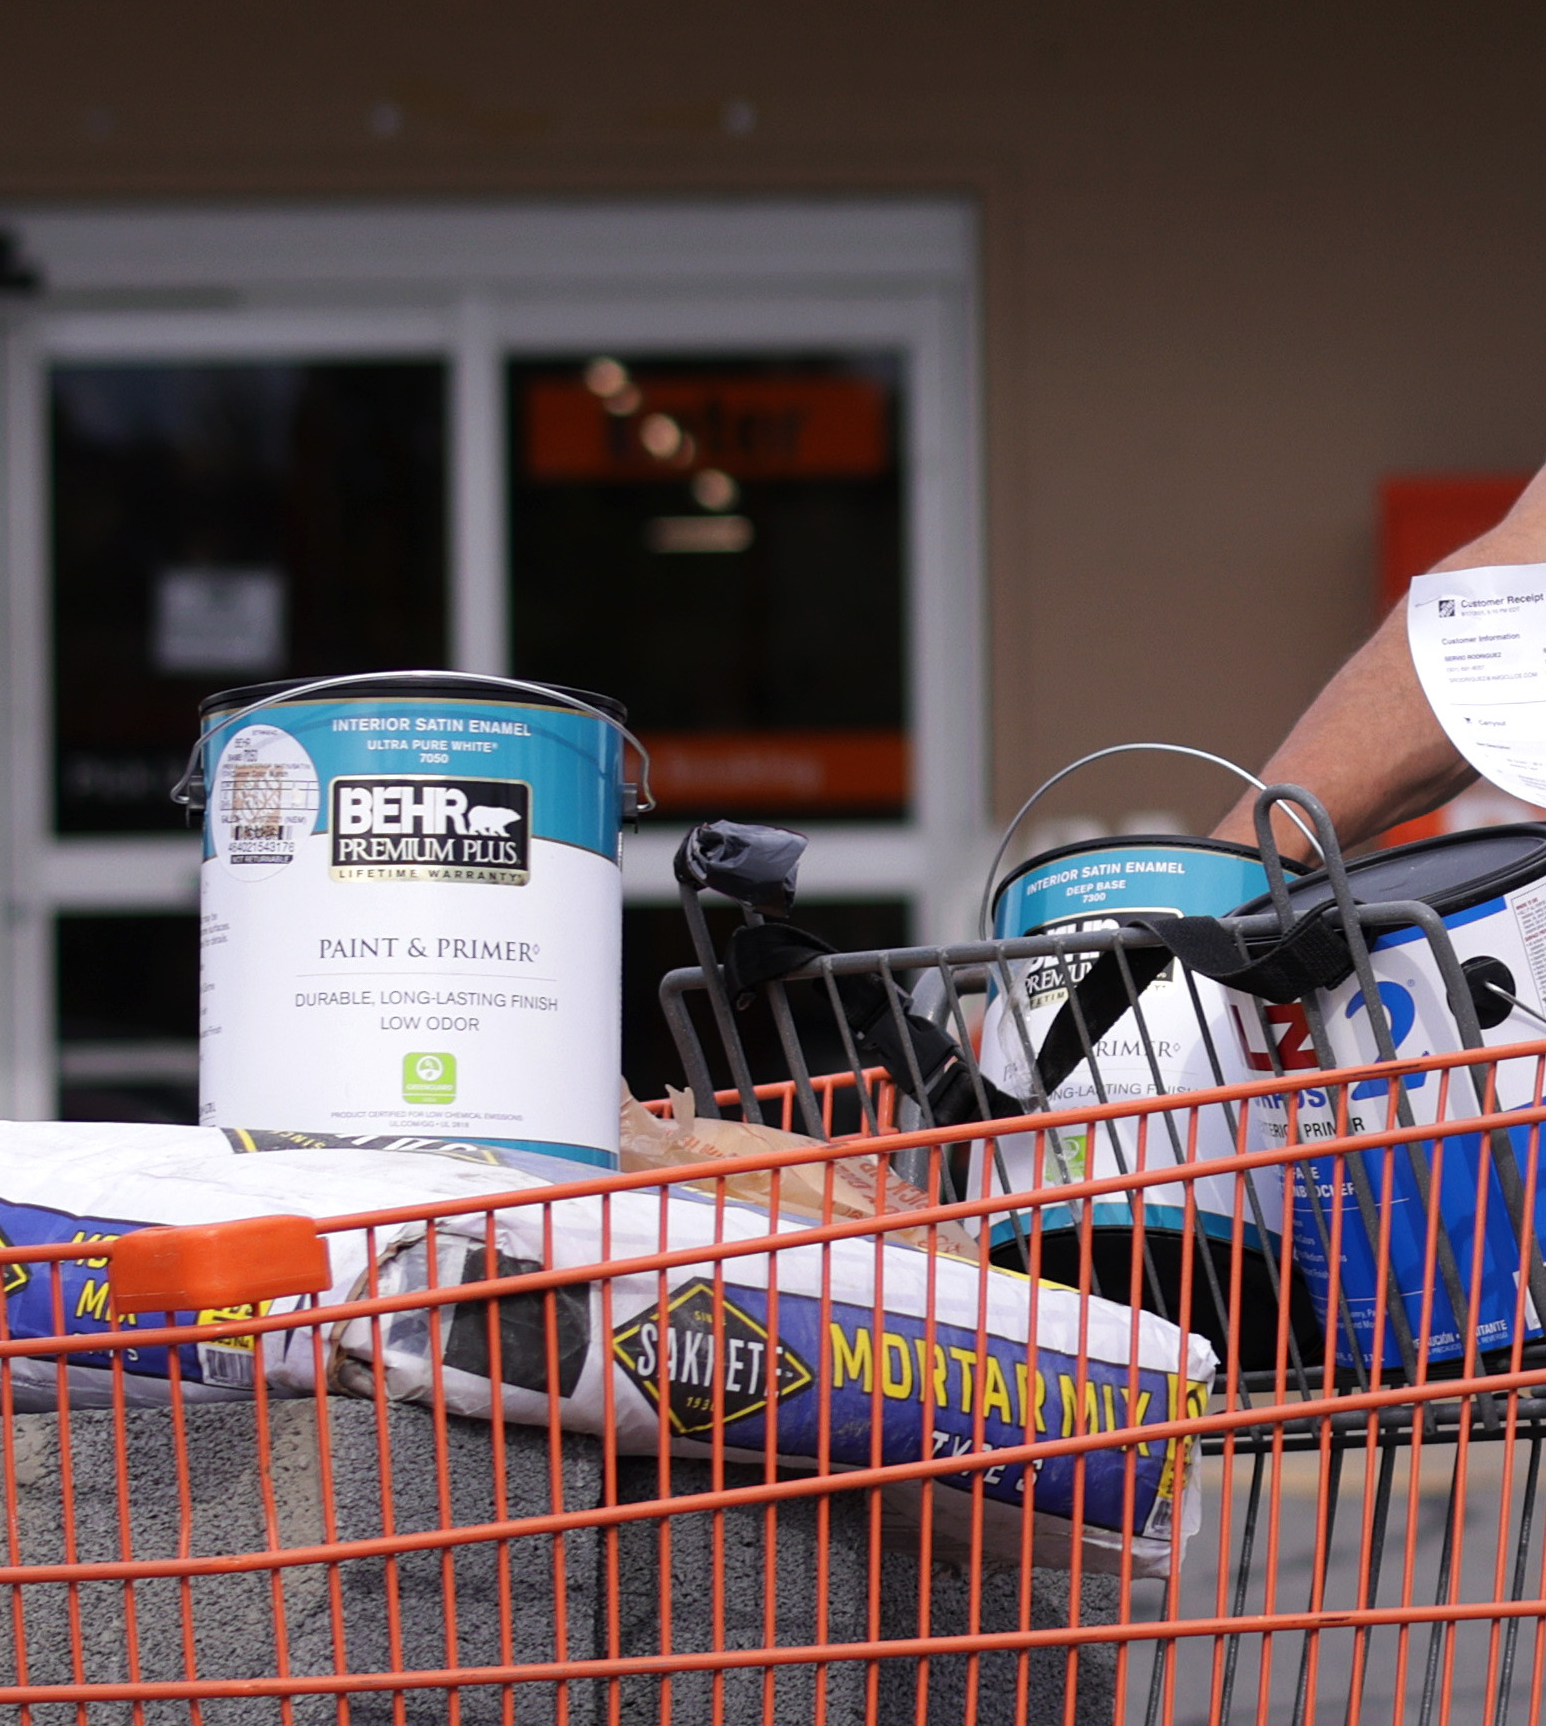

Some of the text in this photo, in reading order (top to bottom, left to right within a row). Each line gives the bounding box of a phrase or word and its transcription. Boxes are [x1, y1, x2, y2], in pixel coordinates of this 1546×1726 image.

[1461, 592, 1544, 608] Customer Receipt
[1442, 632, 1520, 645] Customer Information
[333, 717, 532, 736] INTERIOR SATIN ENAMEL
[367, 740, 408, 751] ULTRA
[412, 740, 448, 751] PURE
[420, 753, 449, 764] 7050
[340, 786, 469, 835] BEHR
[339, 838, 455, 861] PREMIUM
[339, 870, 418, 879] LIFETIME
[1026, 861, 1185, 895] INTERIOR SATIN ENAMEL
[1066, 879, 1127, 897] DEEP BASE
[1083, 892, 1107, 903] 7300
[319, 938, 399, 959] PAINT
[408, 937, 428, 958] &
[295, 991, 558, 1011] DURABLE, LONG-LASTING FINISH
[380, 1016, 480, 1031] LOW ODOR
[331, 1111, 366, 1119] PRODUCT
[444, 1112, 482, 1120] CHEMICAL
[484, 1112, 523, 1122] EMISSIONS
[829, 1323, 1047, 1433] MORTAR
